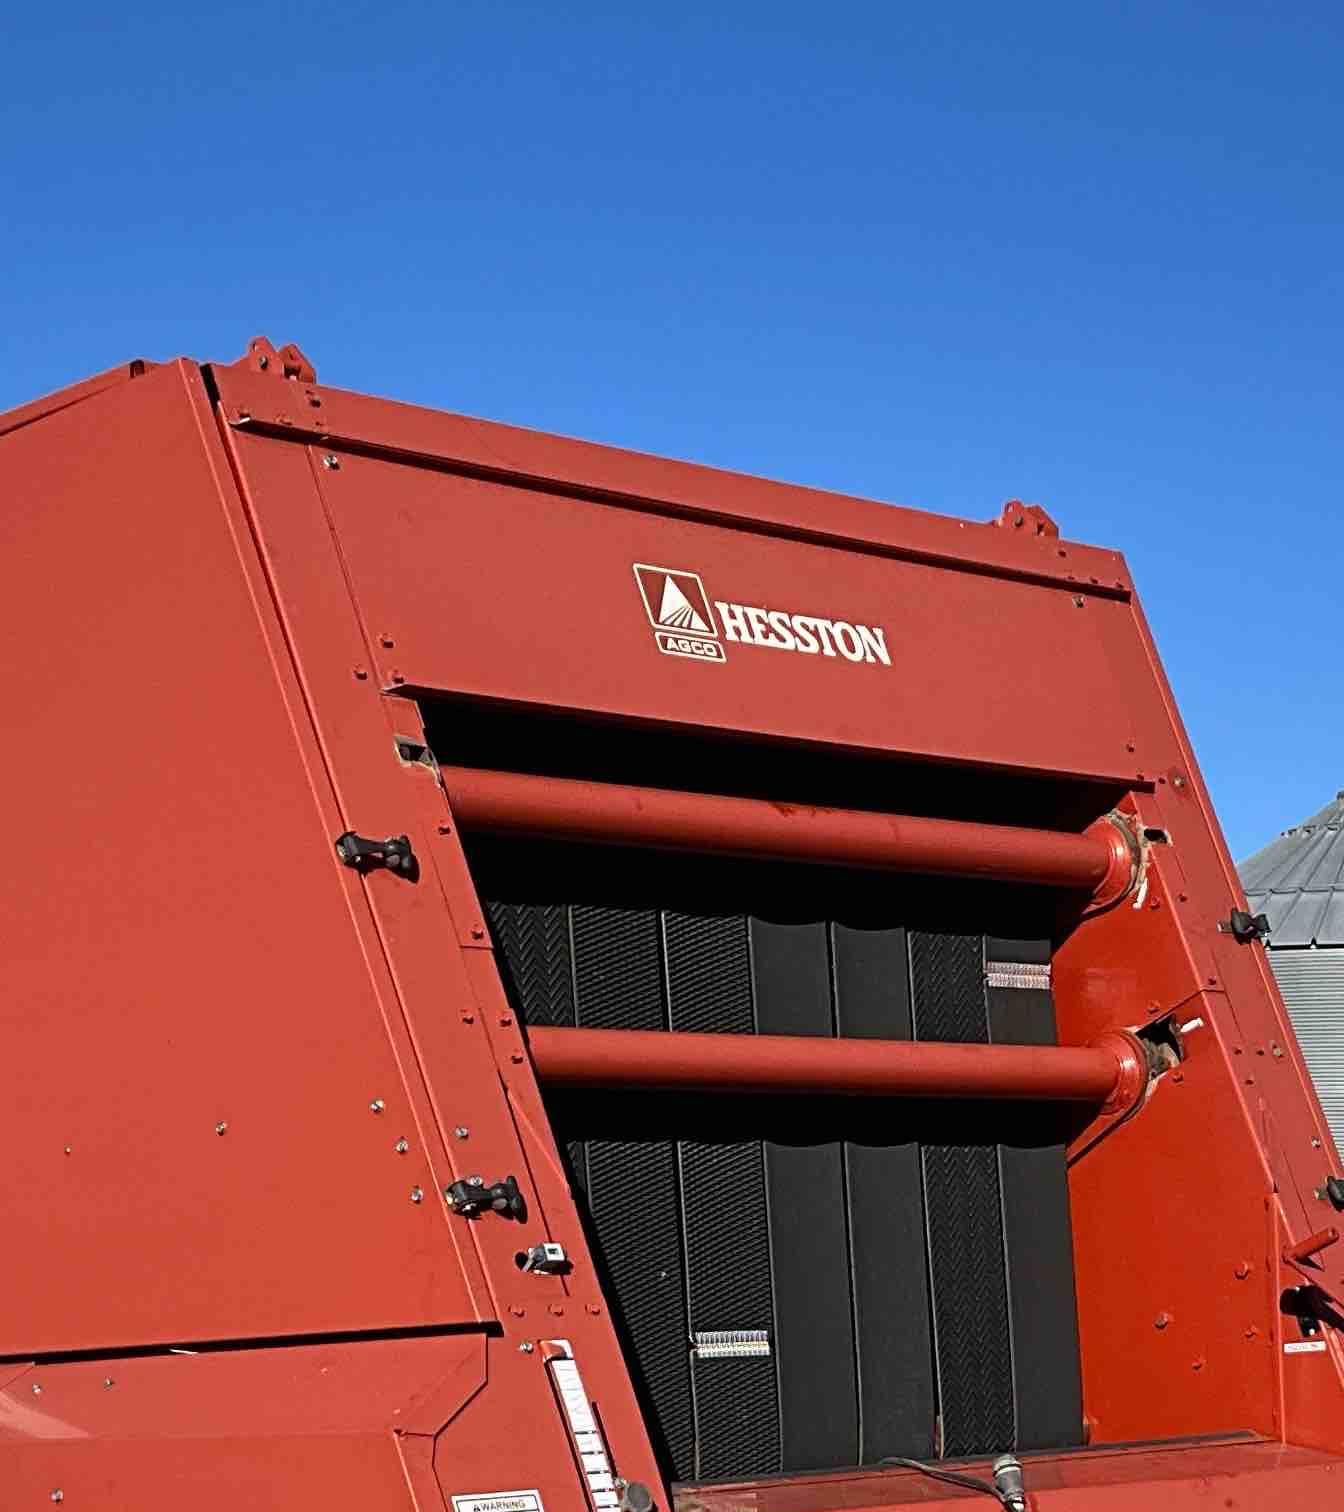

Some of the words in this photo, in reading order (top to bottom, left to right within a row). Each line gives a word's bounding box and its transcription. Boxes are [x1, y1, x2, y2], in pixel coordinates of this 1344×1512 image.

[714, 601, 892, 666] HESSTON
[666, 638, 718, 658] AGCO
[482, 1500, 526, 1511] WARNING
